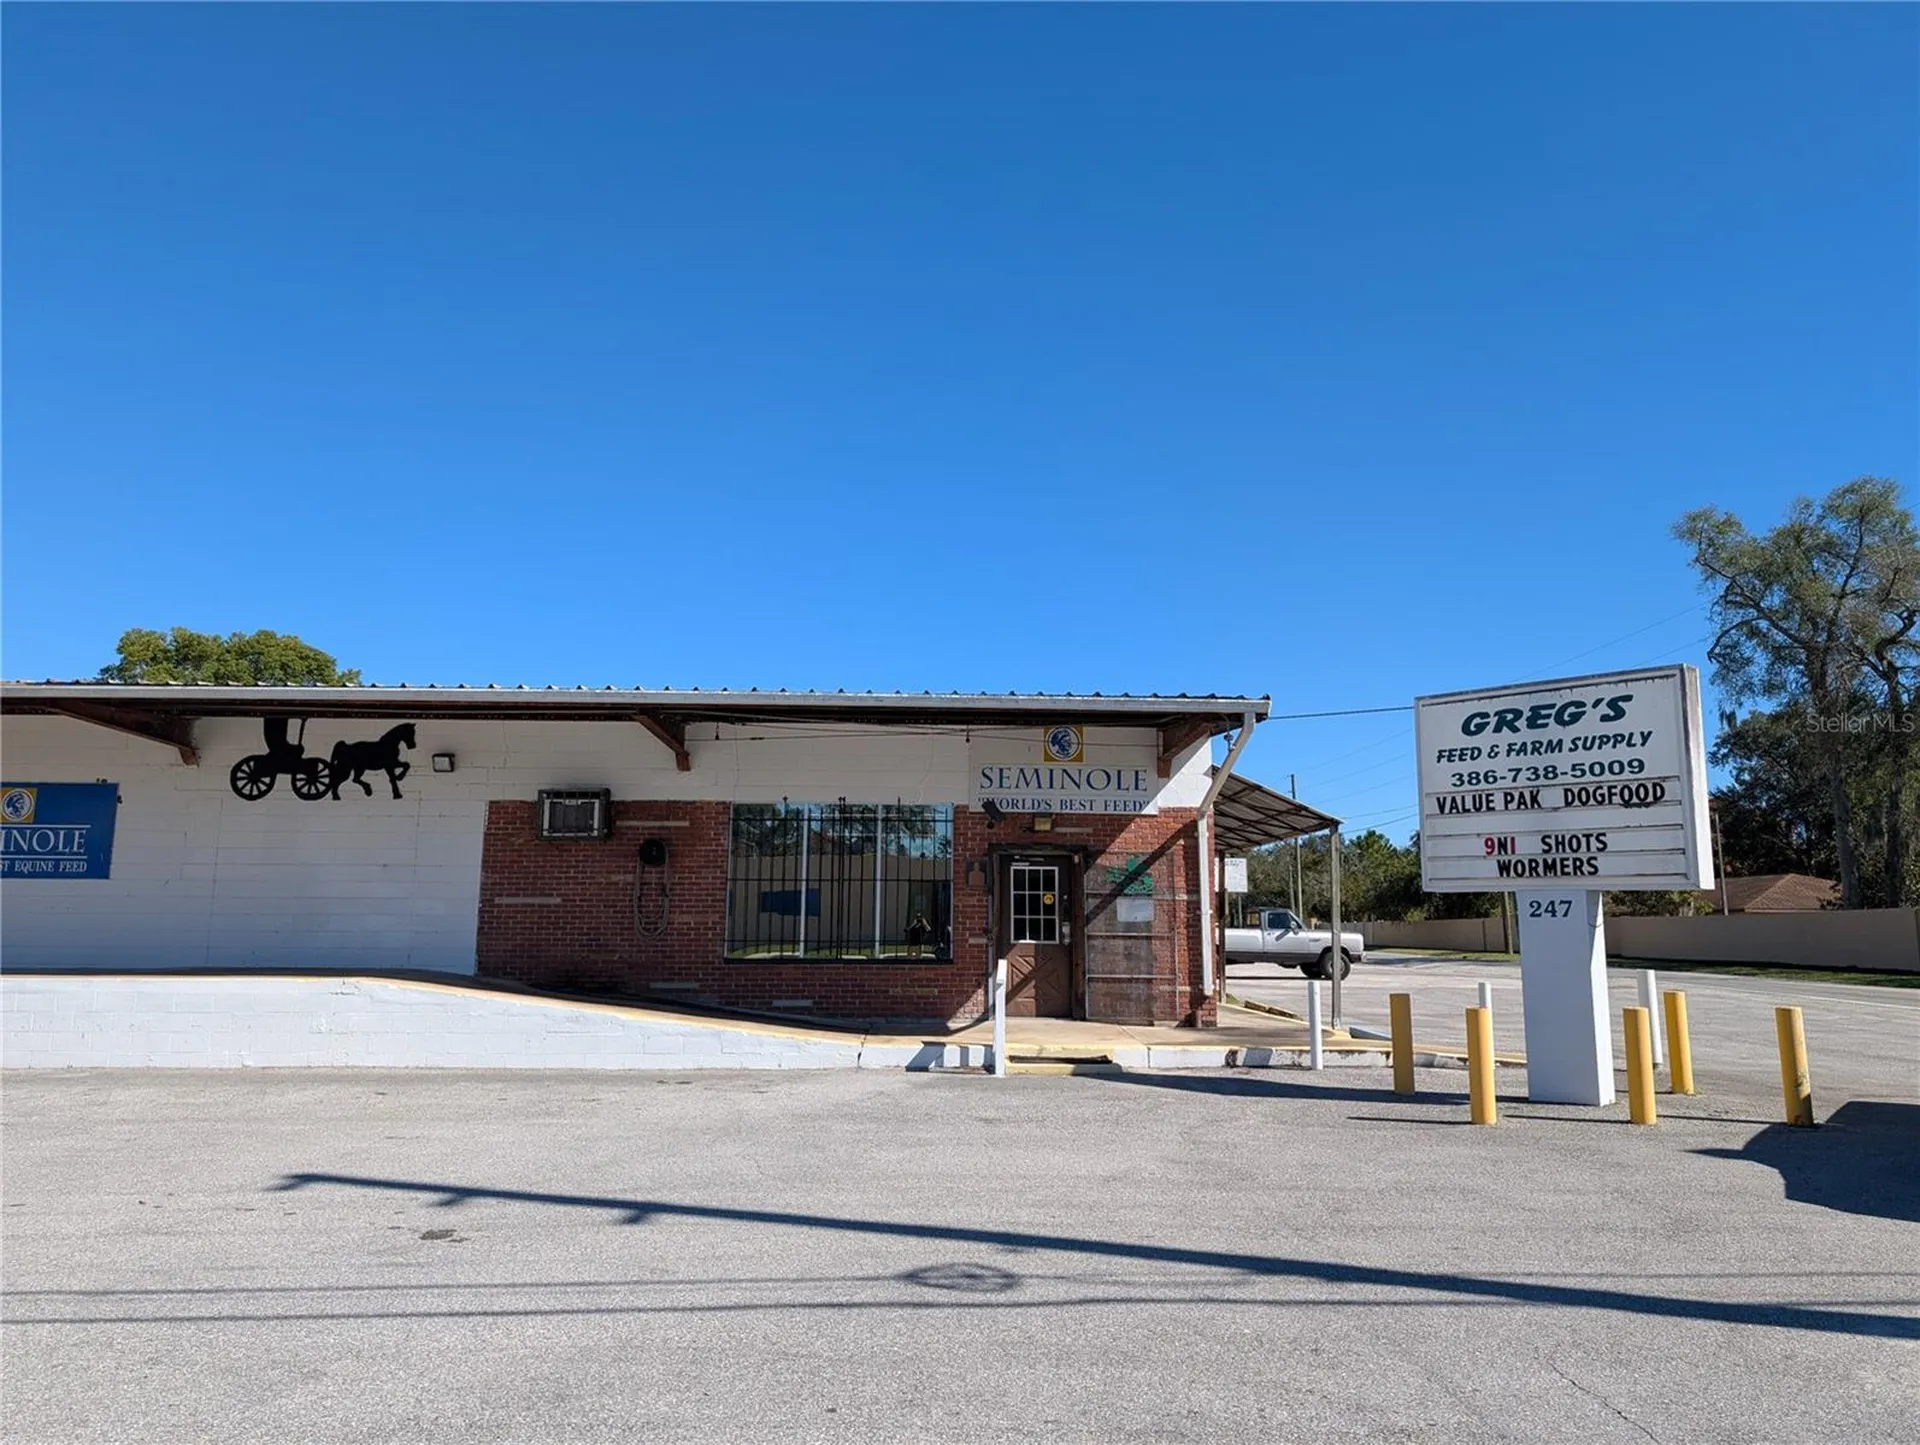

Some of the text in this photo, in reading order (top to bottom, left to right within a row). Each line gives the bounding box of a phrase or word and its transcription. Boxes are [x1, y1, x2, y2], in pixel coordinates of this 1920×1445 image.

[1461, 694, 1634, 737] GREG'S
[1436, 730, 1653, 764] FEED & FARM SUPPLY
[980, 766, 1148, 792] SEMINOLE
[1451, 758, 1645, 788] 386-738-5009
[1059, 799, 1096, 813] BEST
[1436, 781, 1666, 815] VALUE PAK DOGFOOD
[1540, 832, 1608, 854] SHOTS
[14, 861, 55, 874] EQUINE
[59, 861, 87, 873] FEED
[1496, 856, 1599, 878] WORMERS
[1529, 900, 1573, 918] 247
